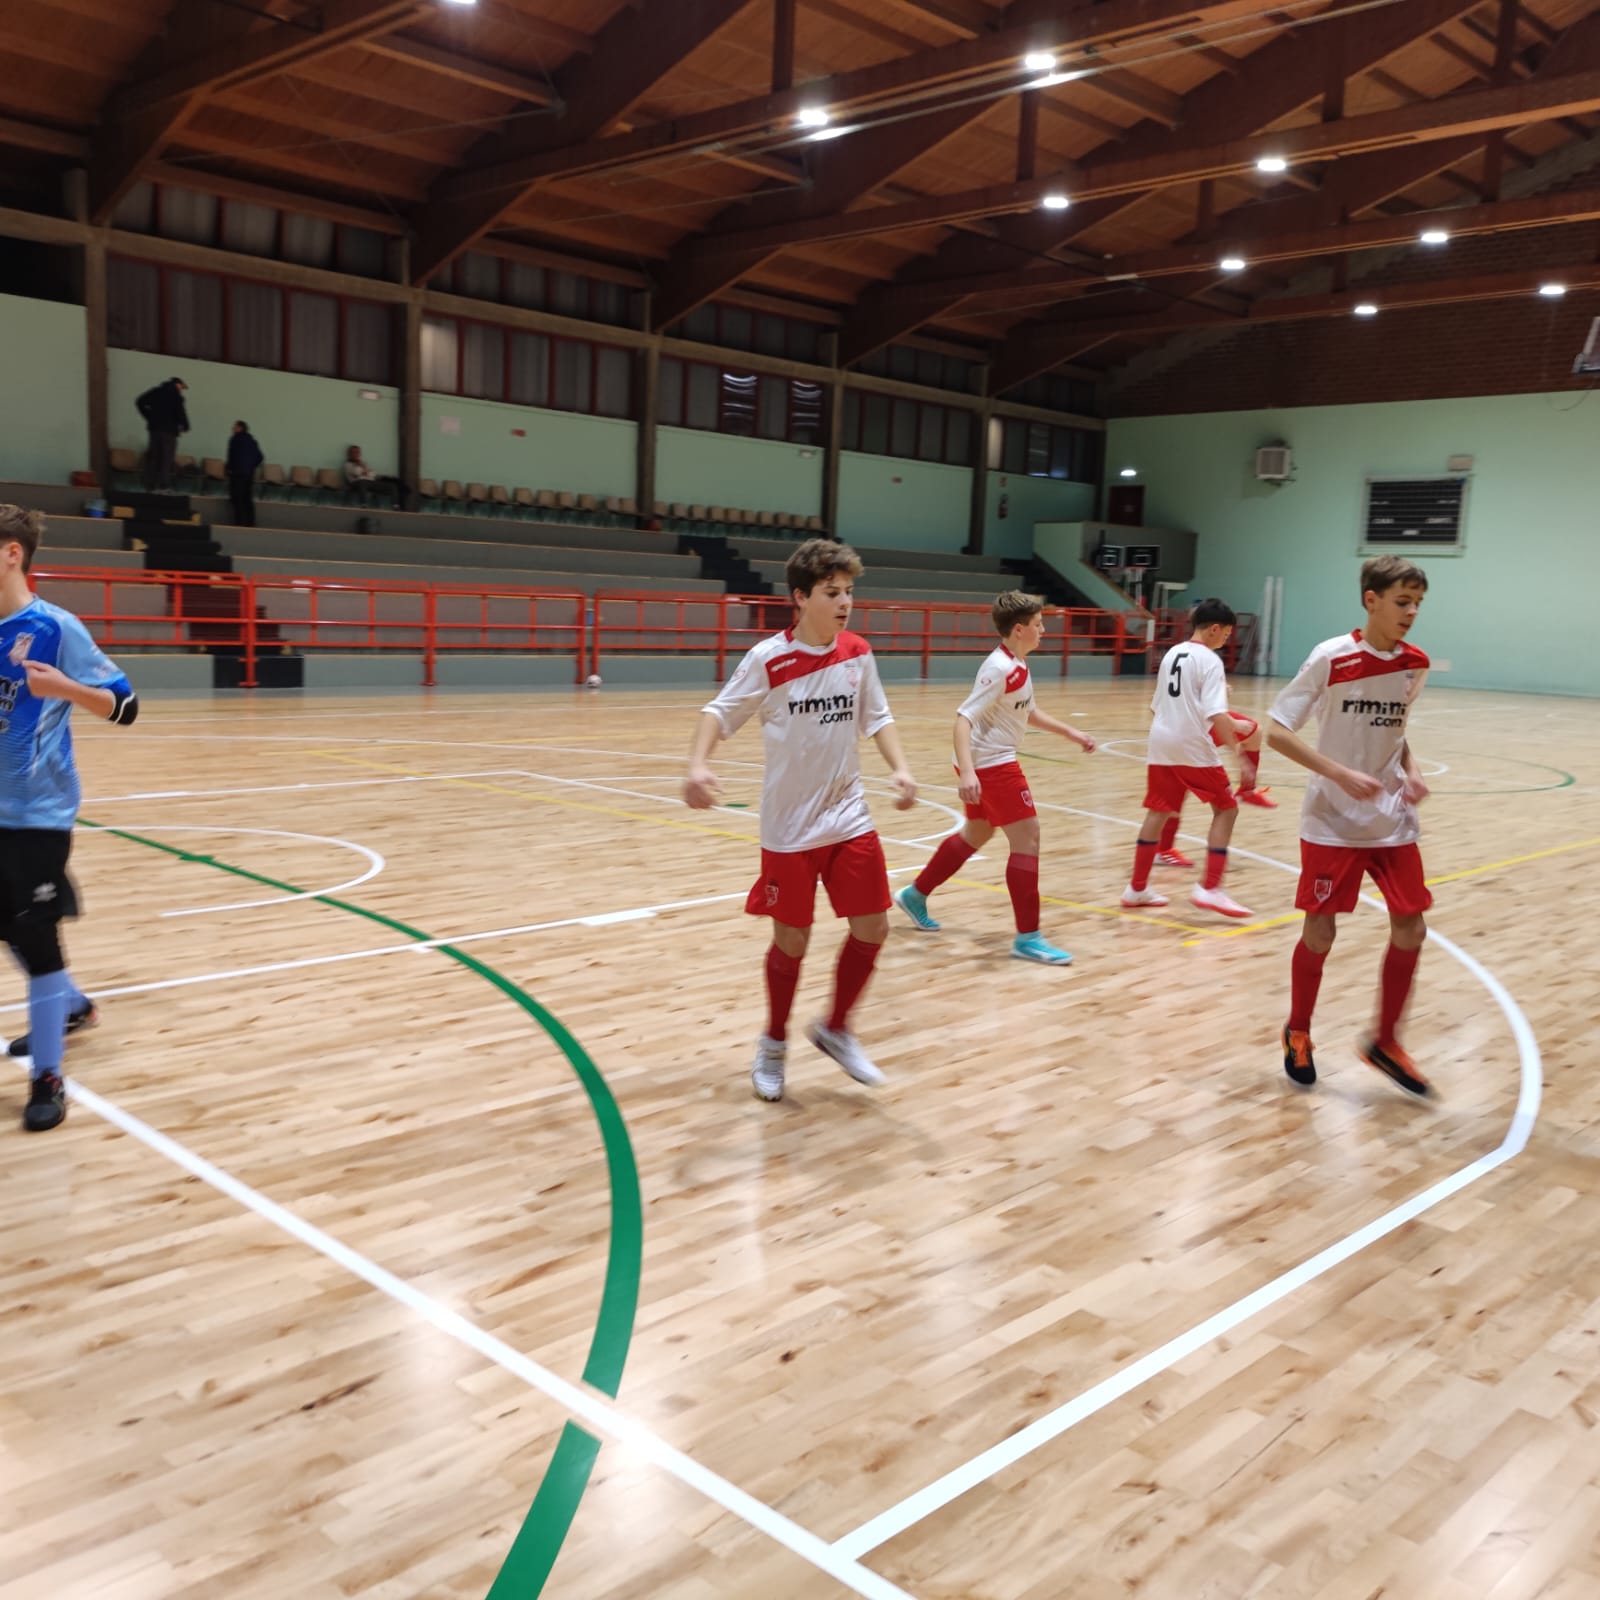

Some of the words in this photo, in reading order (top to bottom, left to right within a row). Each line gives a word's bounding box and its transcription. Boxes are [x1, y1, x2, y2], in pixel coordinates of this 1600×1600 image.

[1168, 652, 1189, 698] 5
[788, 693, 854, 716] rimini
[1342, 699, 1407, 716] rimini
[819, 710, 853, 725] .com
[1369, 717, 1402, 728] .com
